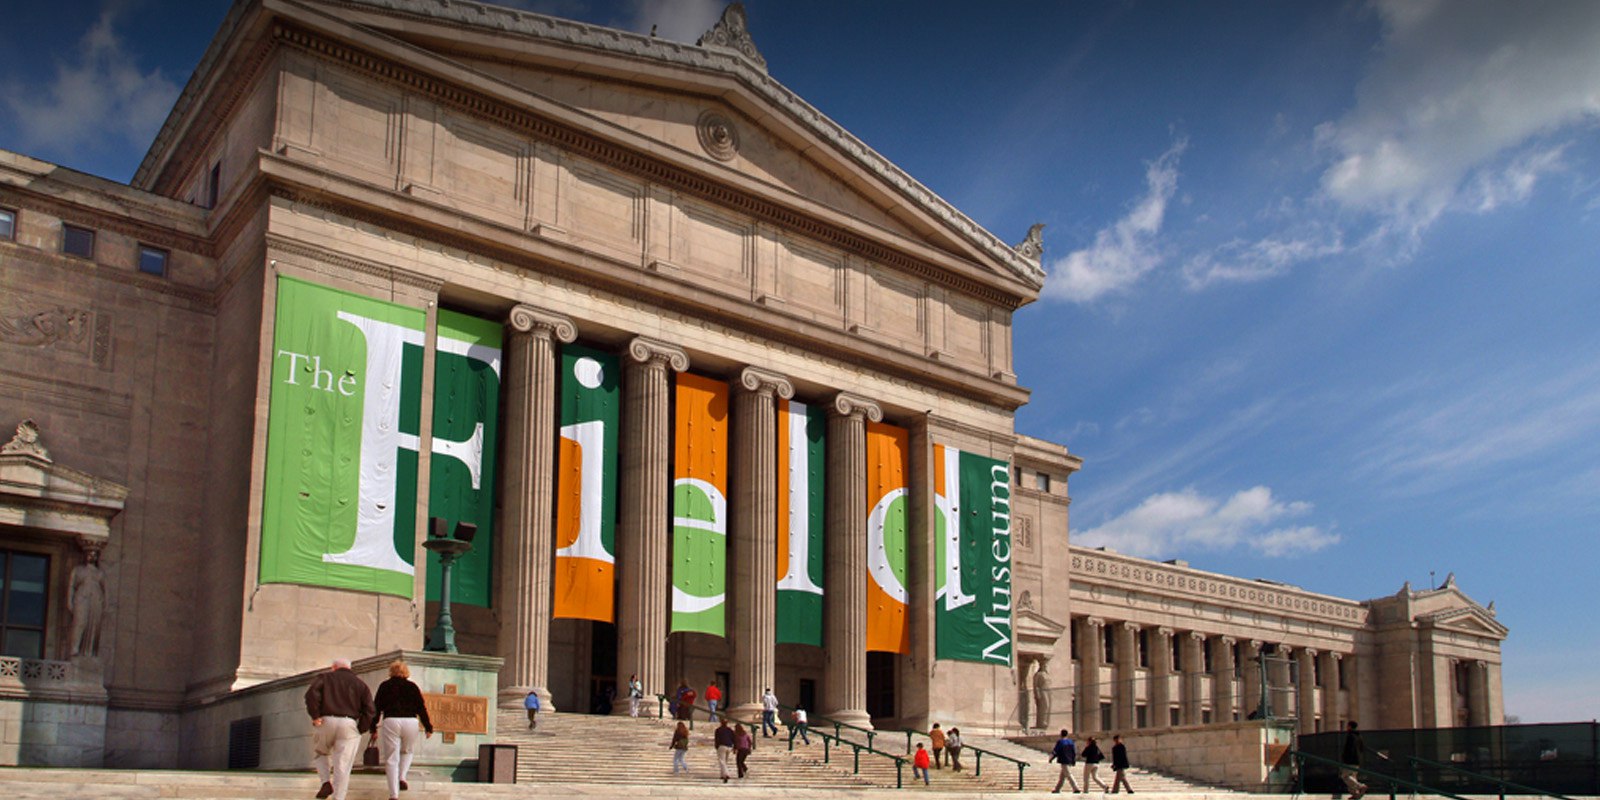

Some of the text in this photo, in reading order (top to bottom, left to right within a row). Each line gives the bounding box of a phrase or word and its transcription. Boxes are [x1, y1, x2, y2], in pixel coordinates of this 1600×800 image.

[278, 310, 1012, 666] The Field Museum
[431, 713, 478, 726] USEUM
